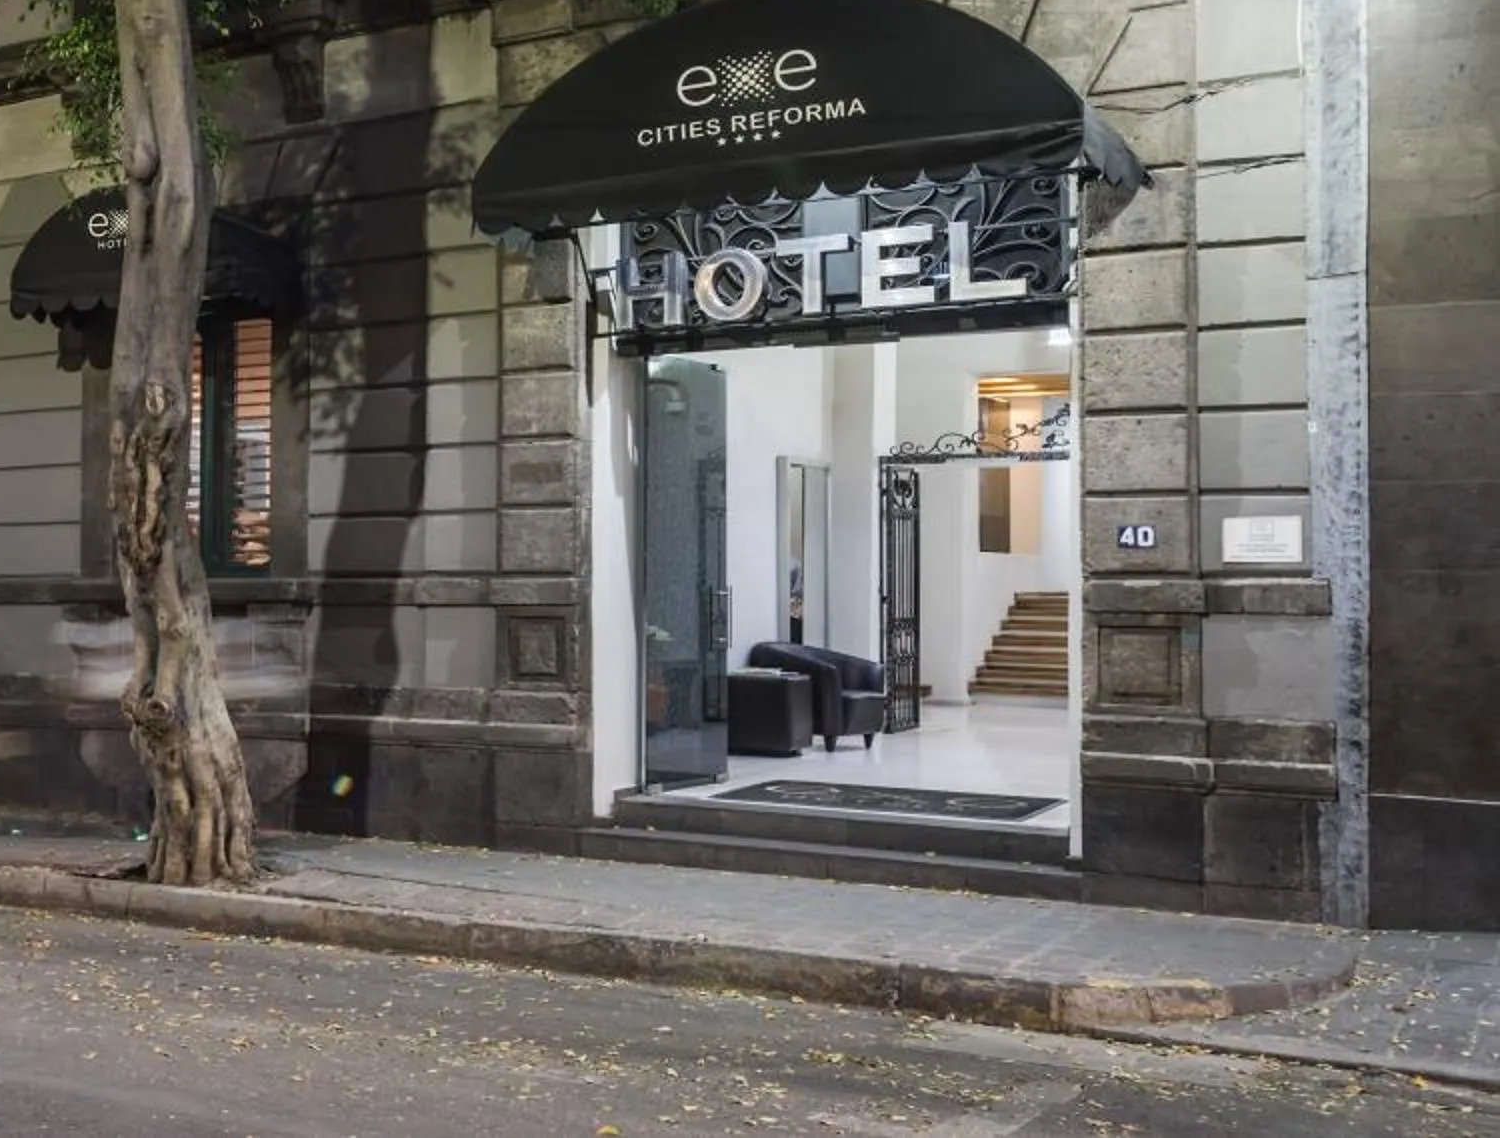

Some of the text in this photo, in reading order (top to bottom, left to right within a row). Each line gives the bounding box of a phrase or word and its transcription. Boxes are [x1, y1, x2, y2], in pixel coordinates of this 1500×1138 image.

[677, 49, 817, 107] exe
[637, 97, 867, 146] CITIES REFORMA
[88, 209, 129, 238] ex
[97, 238, 128, 250] HOT
[616, 221, 1027, 329] HOTEL
[1119, 526, 1155, 548] 40
